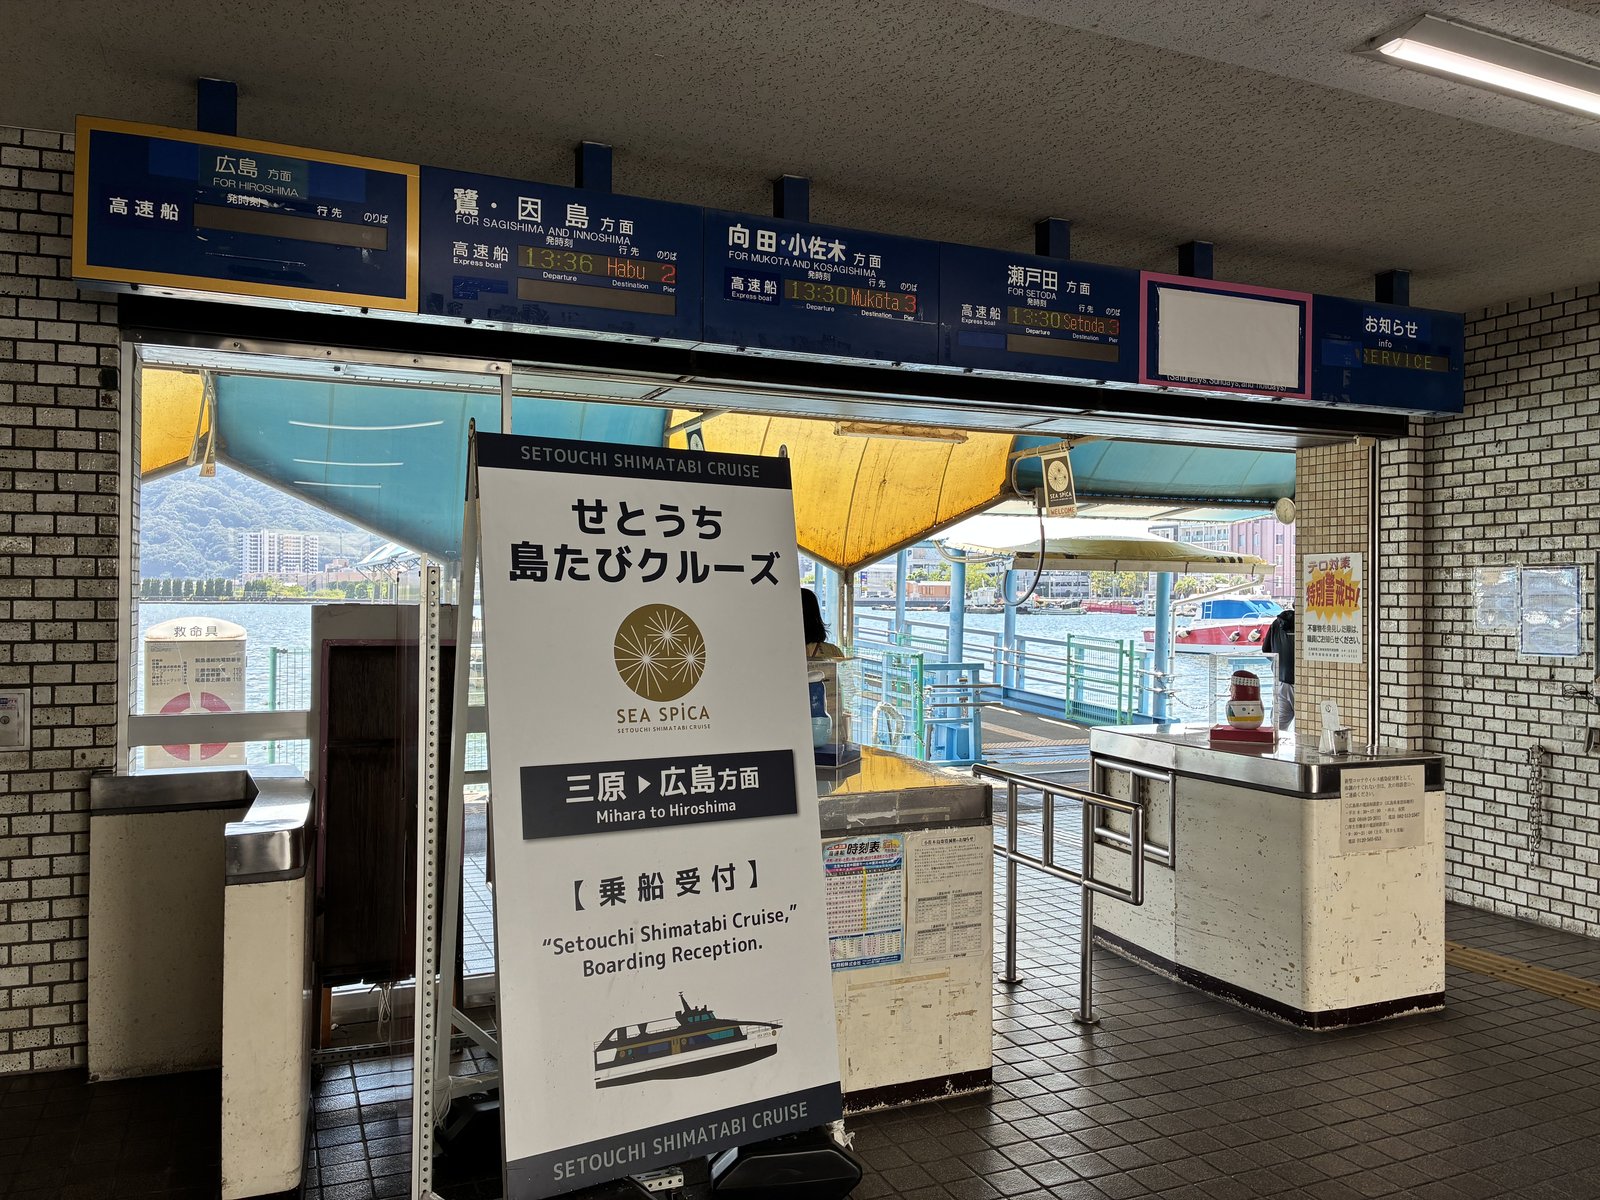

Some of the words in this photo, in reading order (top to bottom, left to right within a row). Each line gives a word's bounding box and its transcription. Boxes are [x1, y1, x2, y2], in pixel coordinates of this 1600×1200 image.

[215, 155, 258, 178] 広島
[268, 168, 292, 183] 方面
[213, 177, 236, 188] FOR
[239, 180, 299, 197] HIROSHIMA
[109, 197, 179, 221] 高速船
[227, 193, 262, 207] 発時刻
[317, 206, 342, 218] 行先
[363, 212, 388, 224] のりば
[456, 214, 479, 226] FOR
[483, 217, 544, 235] SAGISHIMA
[548, 226, 570, 238] AND
[573, 229, 631, 246] INNOSHIMA
[600, 217, 634, 235] 方面
[453, 241, 509, 262] 高速船
[545, 236, 573, 248] 発時刻
[618, 245, 640, 256] 行先
[656, 250, 677, 261] のりば
[728, 223, 846, 262] 向田・小佐木
[853, 253, 882, 269] 方面
[453, 257, 485, 268] Express
[487, 260, 502, 269] boat
[526, 247, 593, 273] 13:36
[607, 257, 646, 280] Habu
[661, 264, 676, 284] 2
[728, 250, 748, 261] FOR
[751, 254, 790, 267] MUKOTA
[792, 259, 811, 269] AND
[813, 262, 877, 278] KOSAGISHIMA
[542, 271, 578, 282] Departure
[612, 279, 649, 290] Destination
[662, 285, 676, 294] Pier
[731, 276, 777, 295] 高速船
[807, 270, 831, 282] 発時刻
[868, 278, 886, 288] 行先
[900, 282, 918, 292] のりば
[1007, 265, 1058, 291] 瀬戸田
[1066, 281, 1091, 296] 方面
[731, 291, 757, 301] Express
[758, 294, 773, 302] boat
[791, 281, 848, 304] 13:30
[904, 294, 917, 313] 3
[1007, 287, 1024, 297] FOR
[1026, 290, 1057, 300] SETODA
[806, 303, 835, 313] Departure
[861, 310, 893, 319] Destination
[961, 303, 1001, 320] 高速船
[1026, 297, 1047, 308] 発時刻
[1078, 304, 1094, 314] 行先
[1105, 307, 1121, 316] のりば
[961, 316, 984, 326] Express
[1012, 308, 1061, 329] 13:30
[1063, 313, 1104, 333] Setoda
[1108, 318, 1120, 335] 3
[1365, 315, 1418, 338] お知らせ
[1025, 328, 1050, 336] Departure
[1072, 332, 1099, 341] Destination
[1378, 338, 1393, 348] info
[520, 445, 607, 467] SETOUCHI
[614, 453, 702, 474] SHIMATABI
[707, 461, 760, 479] CRUISE
[571, 498, 722, 540] せとうち
[1050, 506, 1075, 515] WELCOME
[509, 541, 781, 586] 島たびクルーズ
[1307, 556, 1351, 574] テロ対策
[174, 625, 219, 637] 救命具
[616, 707, 651, 724] SEA
[617, 726, 651, 734] SETOUCHI
[653, 724, 688, 732] SHIMATABI
[566, 771, 627, 804] 三原
[659, 763, 760, 797] 広島方面
[596, 805, 646, 824] Mihara
[650, 805, 666, 819] to
[669, 798, 737, 818] Hiroshima
[847, 841, 880, 855] 時刻表
[640, 914, 728, 944] Shimatabi
[583, 947, 667, 977] Boarding
[672, 935, 763, 965] Reception.
[553, 1143, 647, 1181] SETOUCHI
[652, 1115, 748, 1155] SHIMATABI
[751, 1101, 809, 1130] CRUISE
